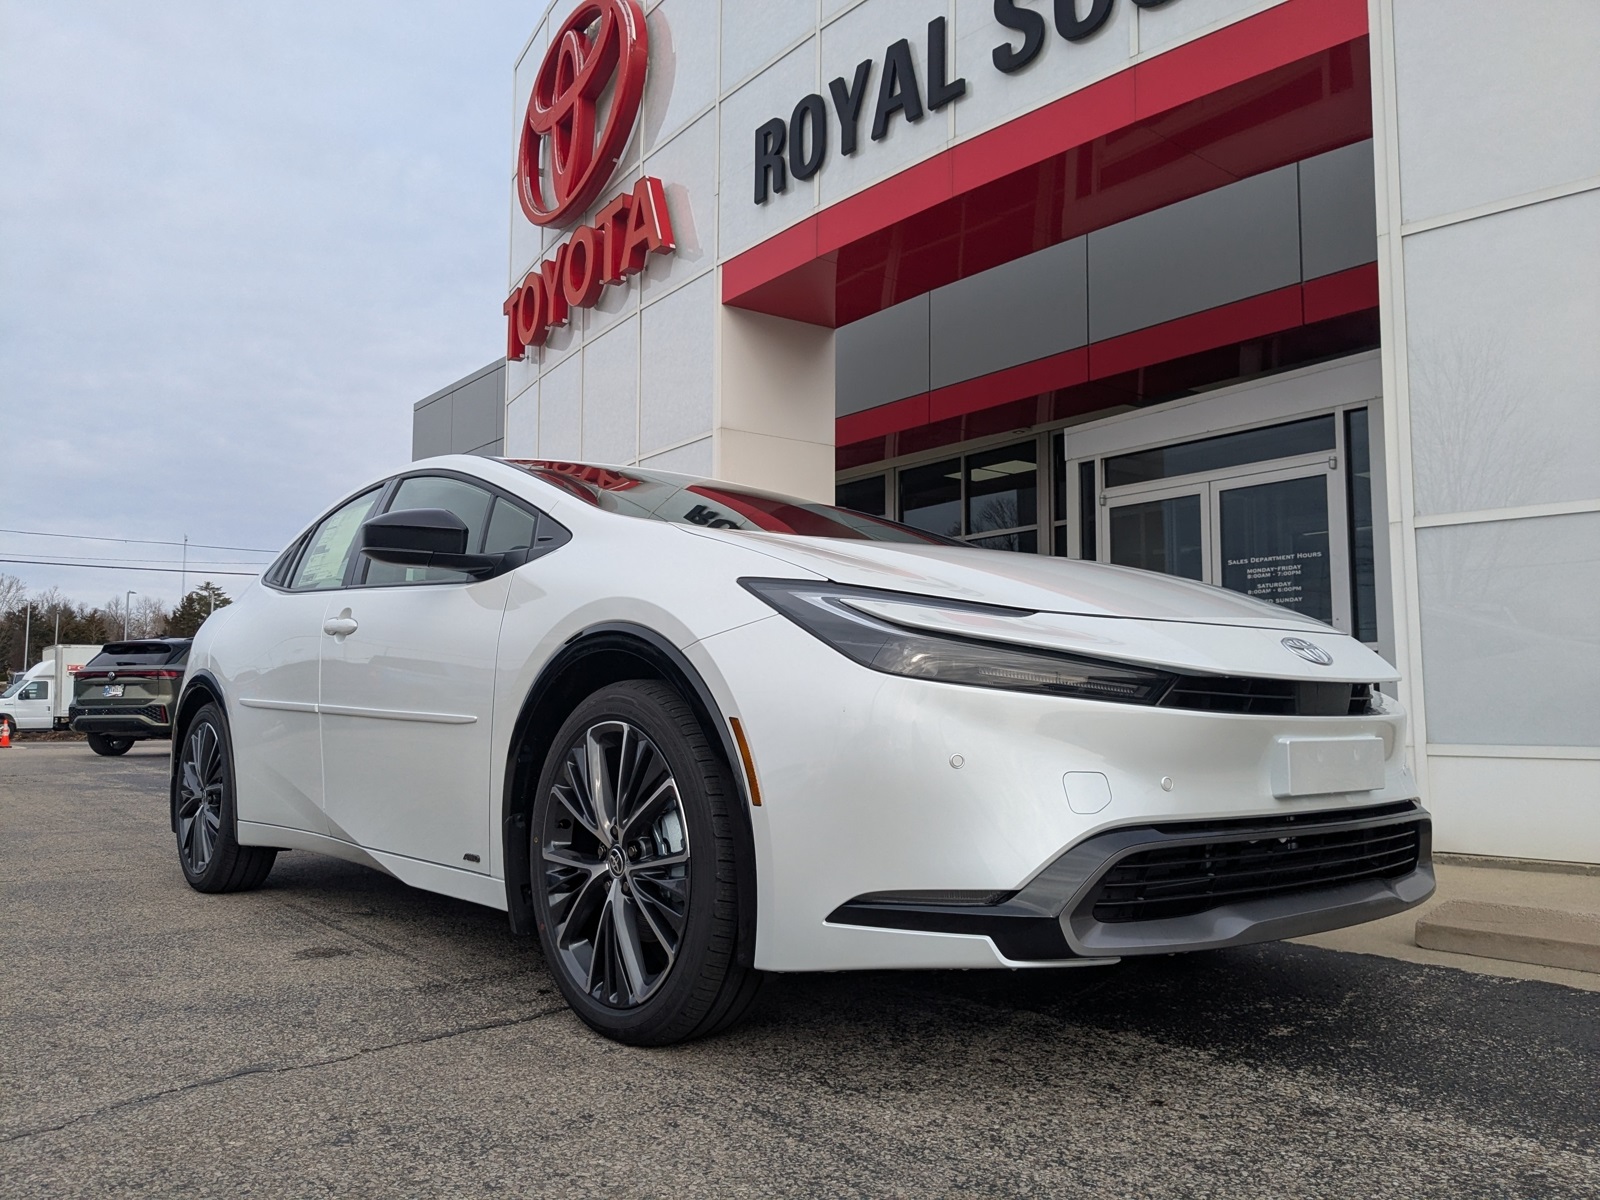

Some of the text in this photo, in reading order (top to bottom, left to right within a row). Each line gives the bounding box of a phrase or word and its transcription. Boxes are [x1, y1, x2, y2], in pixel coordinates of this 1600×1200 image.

[754, 16, 966, 205] ROYAL
[503, 175, 676, 361] TOYOTA
[1250, 554, 1295, 563] DEPARTMENT
[1297, 551, 1322, 559] HOURS
